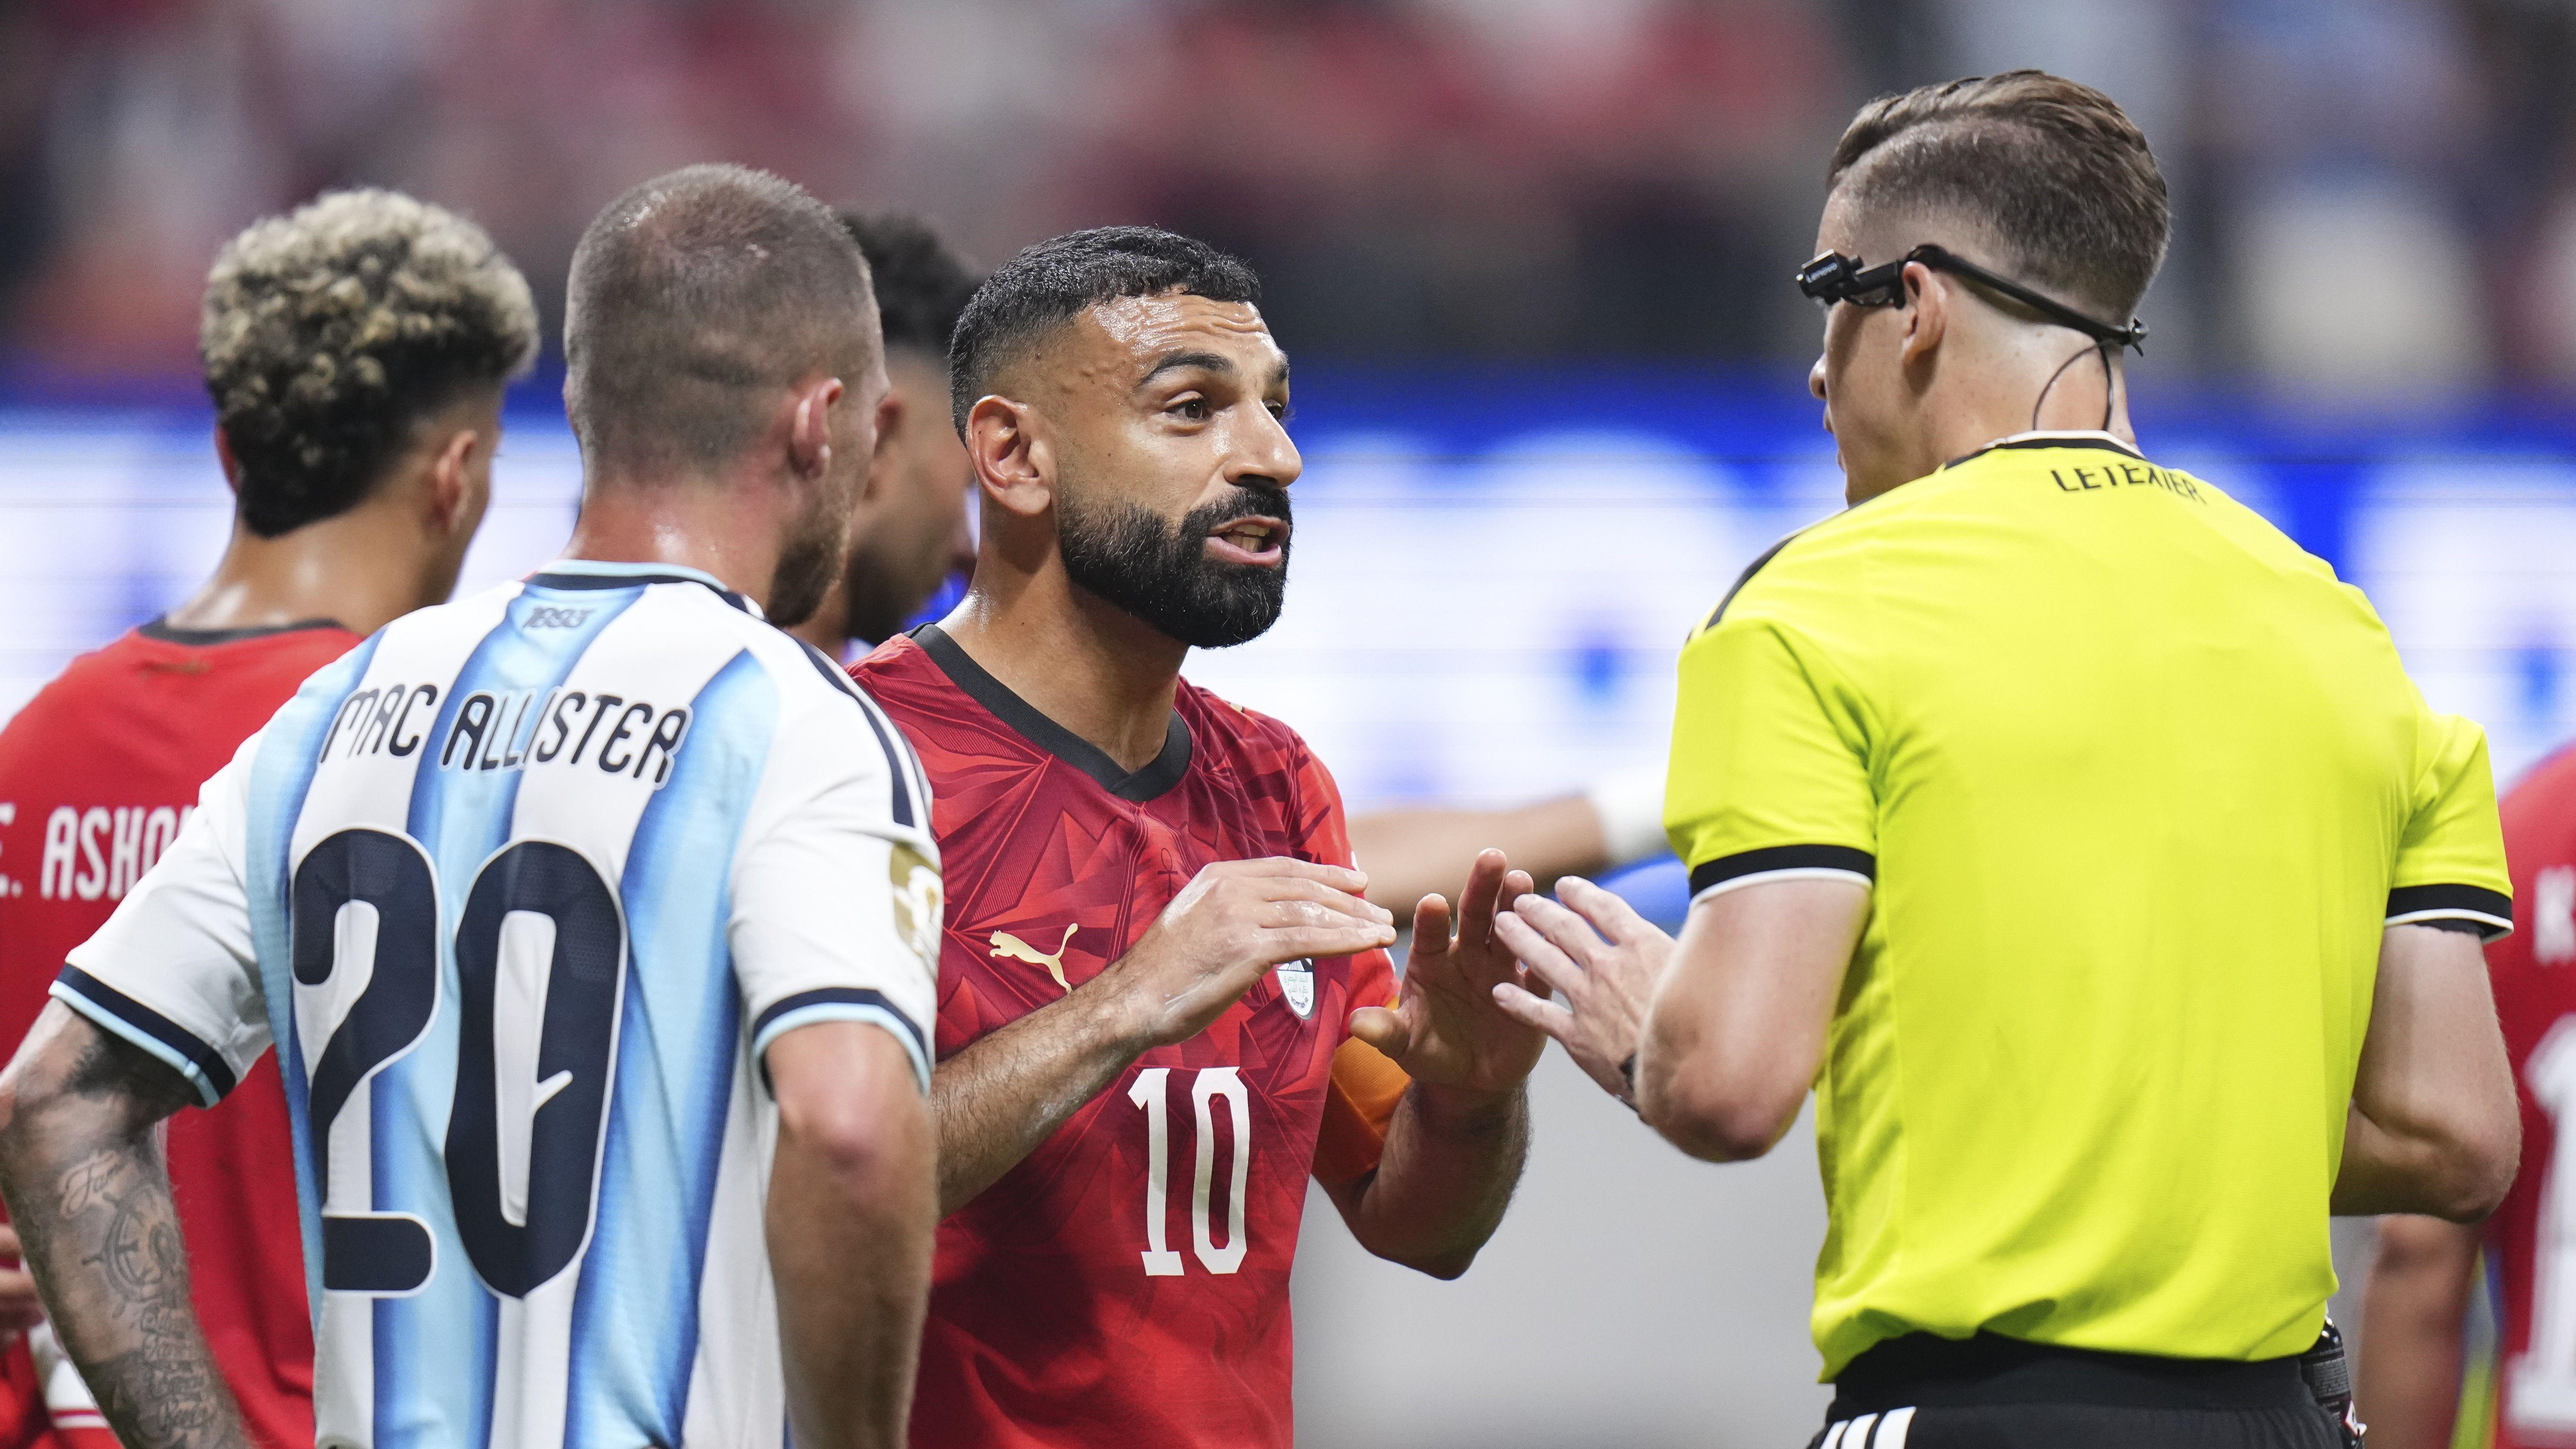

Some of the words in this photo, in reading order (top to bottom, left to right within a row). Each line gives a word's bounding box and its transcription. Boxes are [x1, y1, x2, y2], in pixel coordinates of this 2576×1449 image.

[320, 683, 437, 765] MAC
[441, 686, 691, 786] ALLISTER
[41, 805, 197, 901] ASHO
[292, 828, 622, 1299] 20
[1127, 1066, 1251, 1276] 10
